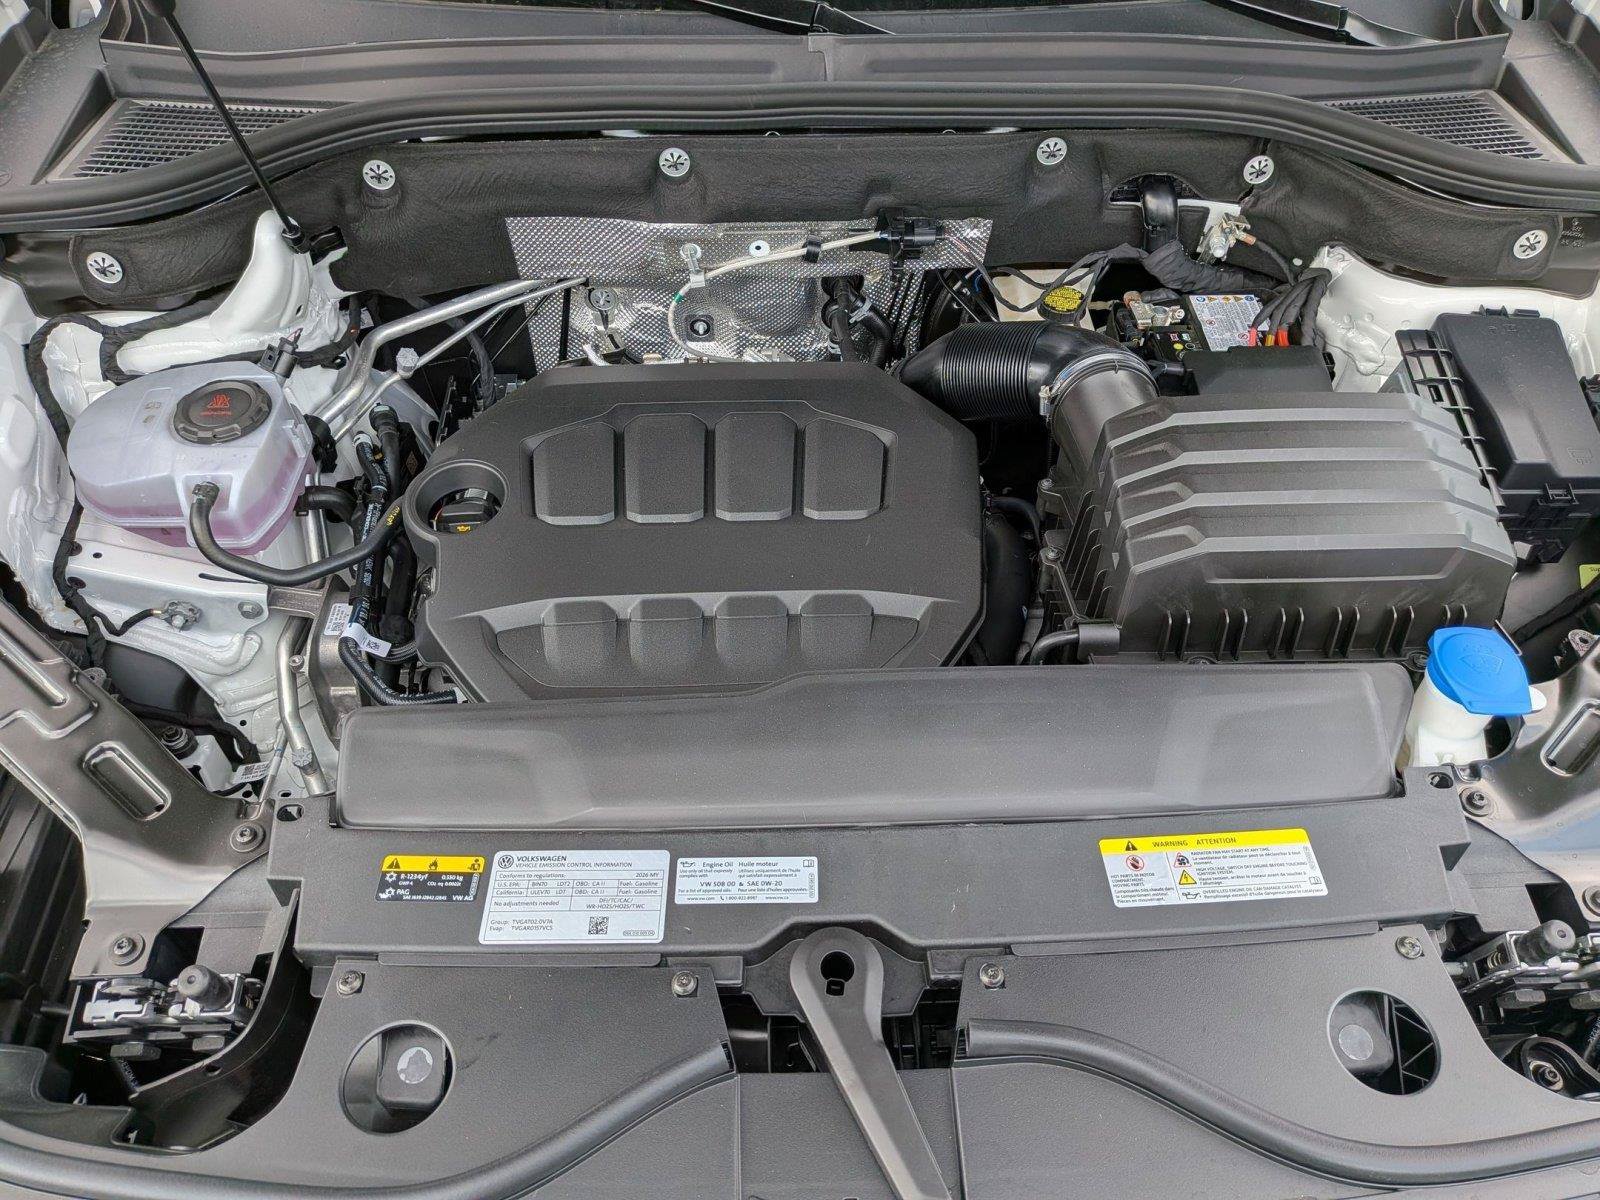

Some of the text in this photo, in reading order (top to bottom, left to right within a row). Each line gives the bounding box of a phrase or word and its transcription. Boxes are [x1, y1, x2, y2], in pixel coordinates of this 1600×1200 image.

[1151, 837, 1237, 848] WARNING ATTENTION
[400, 873, 429, 881] R-1234yf
[534, 872, 566, 880] regulations:
[502, 900, 538, 908] adjustments
